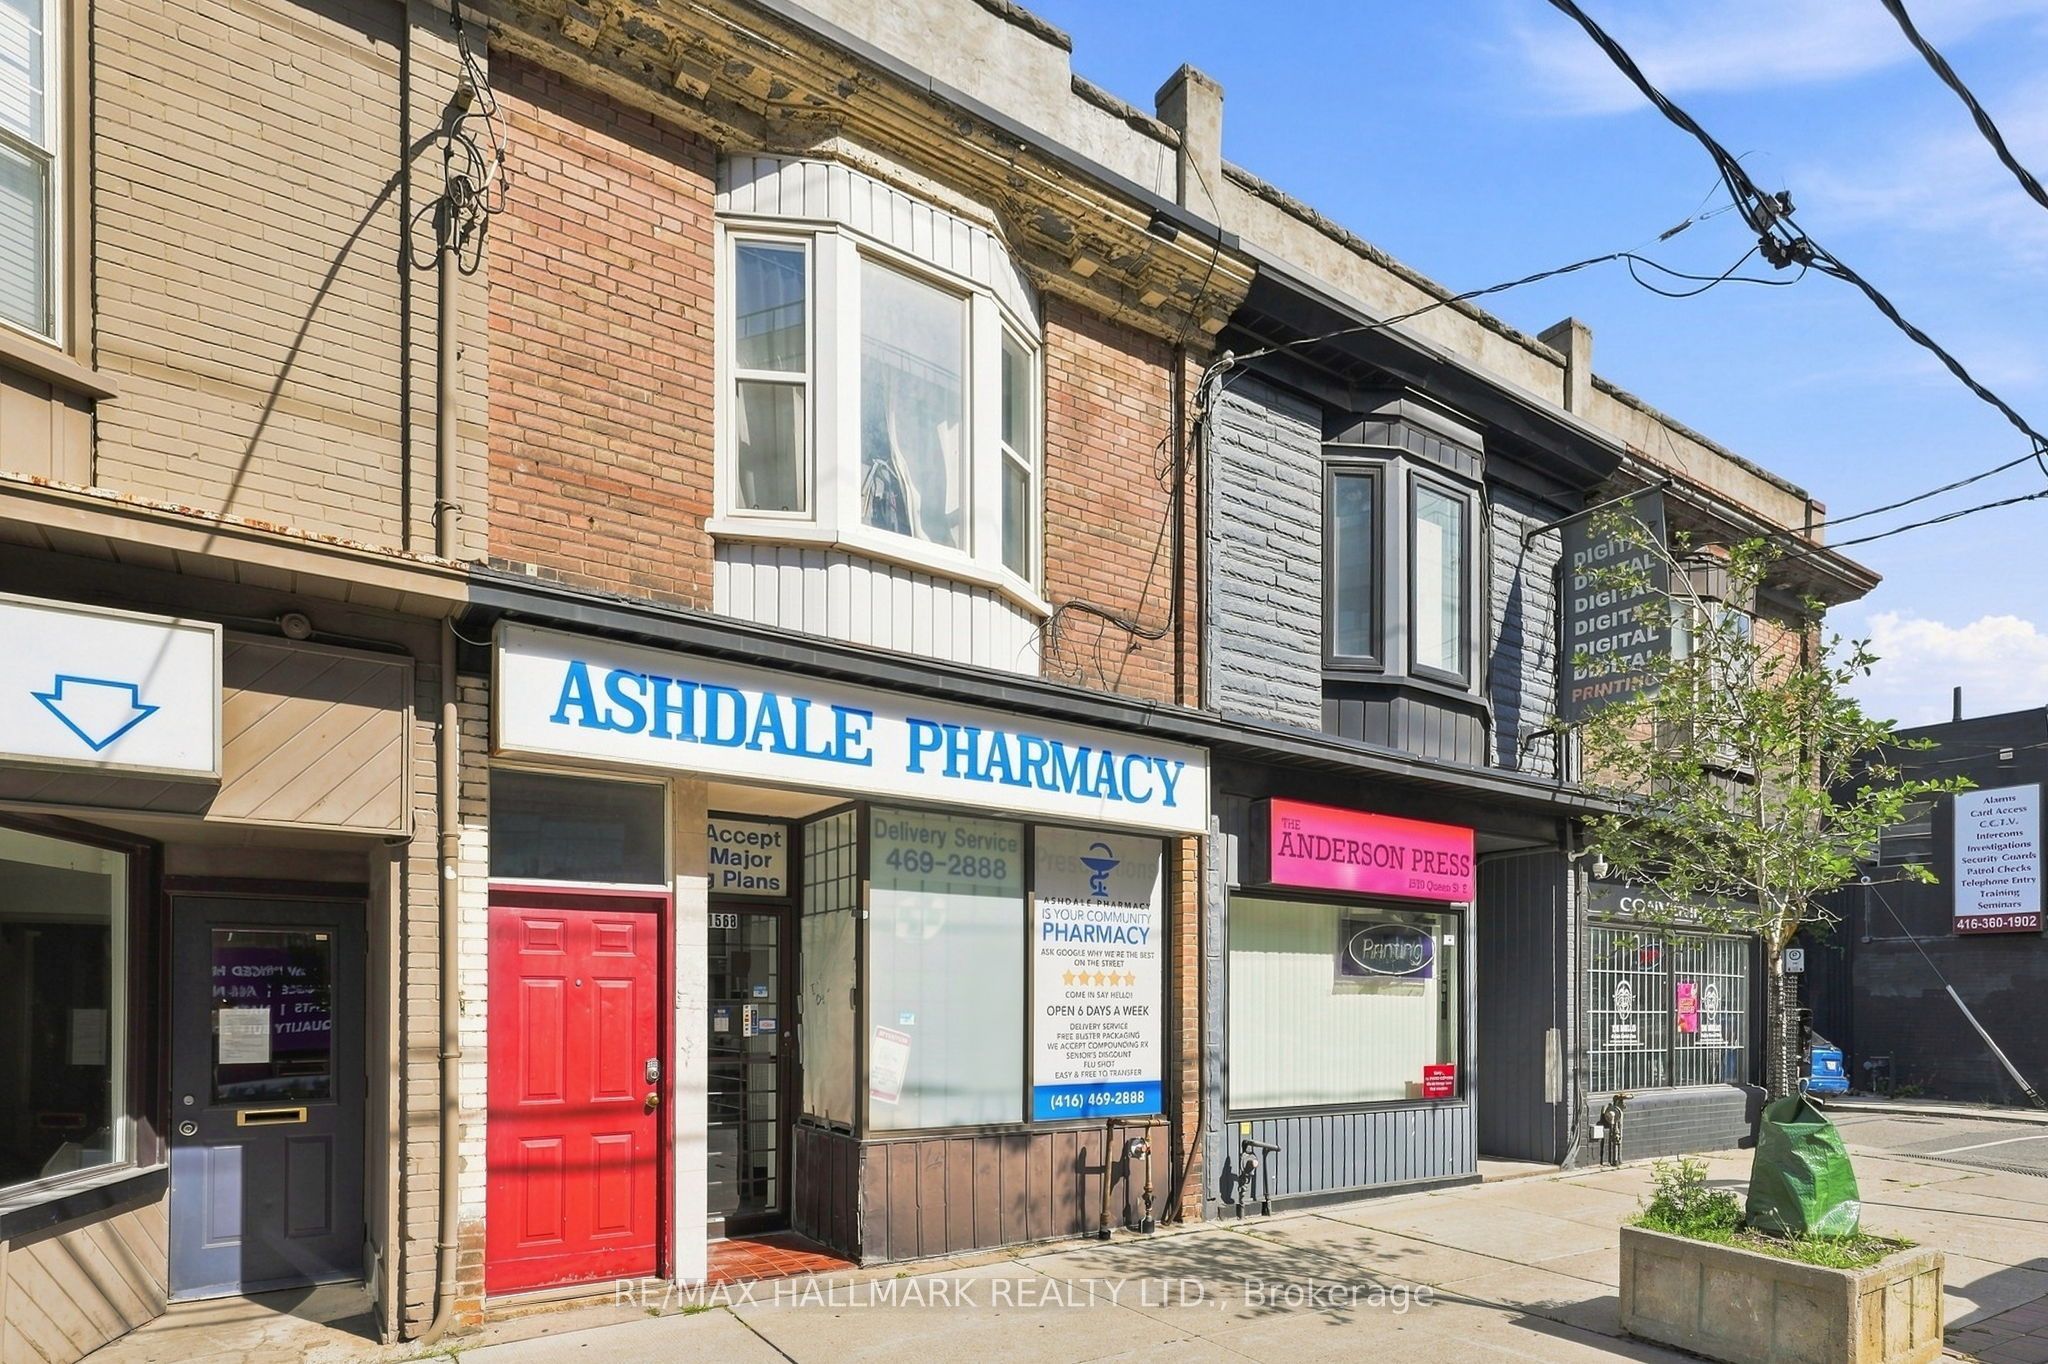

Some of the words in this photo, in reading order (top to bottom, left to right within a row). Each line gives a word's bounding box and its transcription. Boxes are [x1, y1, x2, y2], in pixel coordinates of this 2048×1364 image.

[1573, 527, 1657, 568] DIGIT
[550, 659, 874, 767] ASHDALE
[906, 716, 1185, 807] PHARMACY
[1983, 795, 2016, 804] Alarms
[1970, 808, 1993, 818] Card
[1996, 806, 2027, 815] Access
[1281, 817, 1301, 830] THE
[707, 824, 781, 849] Accept
[874, 817, 947, 848] Delivery
[954, 827, 1018, 854] Service
[1976, 830, 2023, 840] Intercoms
[1967, 841, 2032, 852] Investigations
[710, 847, 772, 870] Major
[1278, 831, 1405, 870] ANDERSON
[1412, 848, 1470, 878] PRESS
[1962, 854, 1998, 865] Security
[2001, 851, 2037, 862] Guards
[886, 847, 1007, 880] 469-2888
[1967, 866, 1995, 876] Patrol
[1997, 864, 2032, 873] Checks
[723, 870, 780, 890] Plans
[1961, 878, 2009, 888] Telephone
[2011, 875, 2036, 885] Entry
[1980, 889, 2020, 898] Training
[1044, 897, 1092, 907] ASHDALE
[1097, 900, 1150, 910] PHARMACY
[1977, 901, 2022, 910] Seminars
[709, 914, 737, 928] 1568
[1042, 908, 1051, 919] IS
[1054, 909, 1083, 920] YOUR
[1087, 910, 1151, 924] COMMUNITY
[1957, 915, 2037, 929] 416-360-1902
[1043, 922, 1150, 945] PHARMACY
[1056, 949, 1085, 957] GOOGLE
[1127, 951, 1138, 959] THE
[1363, 937, 1423, 966] Printing
[1065, 991, 1085, 999] COME
[1088, 991, 1095, 999] IN
[1096, 991, 1109, 999] SAY
[1047, 1005, 1075, 1016] OPEN
[1078, 1005, 1083, 1016] 6
[1086, 1005, 1111, 1016] DAYS
[1114, 1005, 1120, 1016] A
[1122, 1005, 1149, 1016] WEEK
[1070, 1023, 1100, 1031] DELIVERY
[1103, 1022, 1128, 1030] SERVICE
[1103, 1031, 1140, 1039] PACKAGING
[1061, 1042, 1086, 1050] ACCEPT
[1088, 1041, 1138, 1049] COMPOUNDING
[1097, 1060, 1115, 1068] SHOT
[1055, 1071, 1072, 1079] EASY
[1081, 1070, 1096, 1078] FREE
[1050, 1093, 1083, 1110] (416)
[1088, 1091, 1144, 1105] 469-2888
